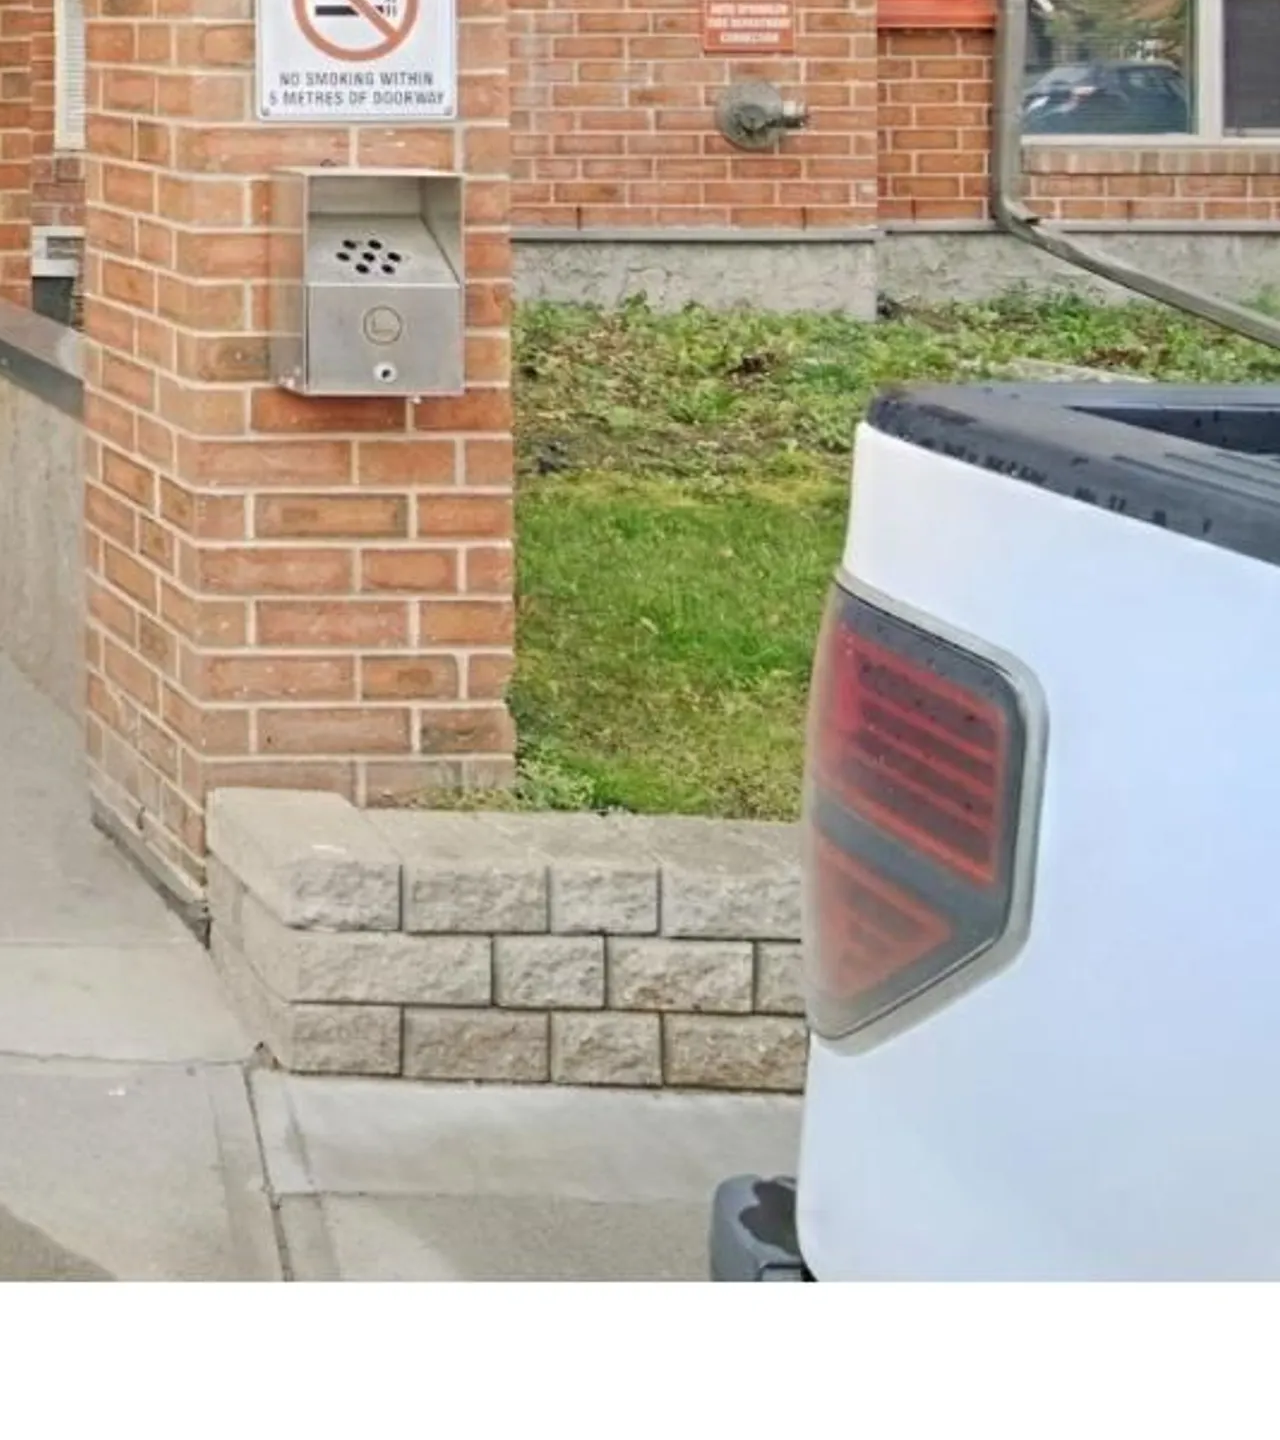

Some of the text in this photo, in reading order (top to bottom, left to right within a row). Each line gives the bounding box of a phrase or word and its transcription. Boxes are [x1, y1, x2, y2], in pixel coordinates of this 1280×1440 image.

[278, 71, 434, 86] NO SMOKING WITHIN
[282, 90, 345, 105] METRES
[348, 90, 368, 105] OF
[372, 90, 445, 105] DOORWAY
